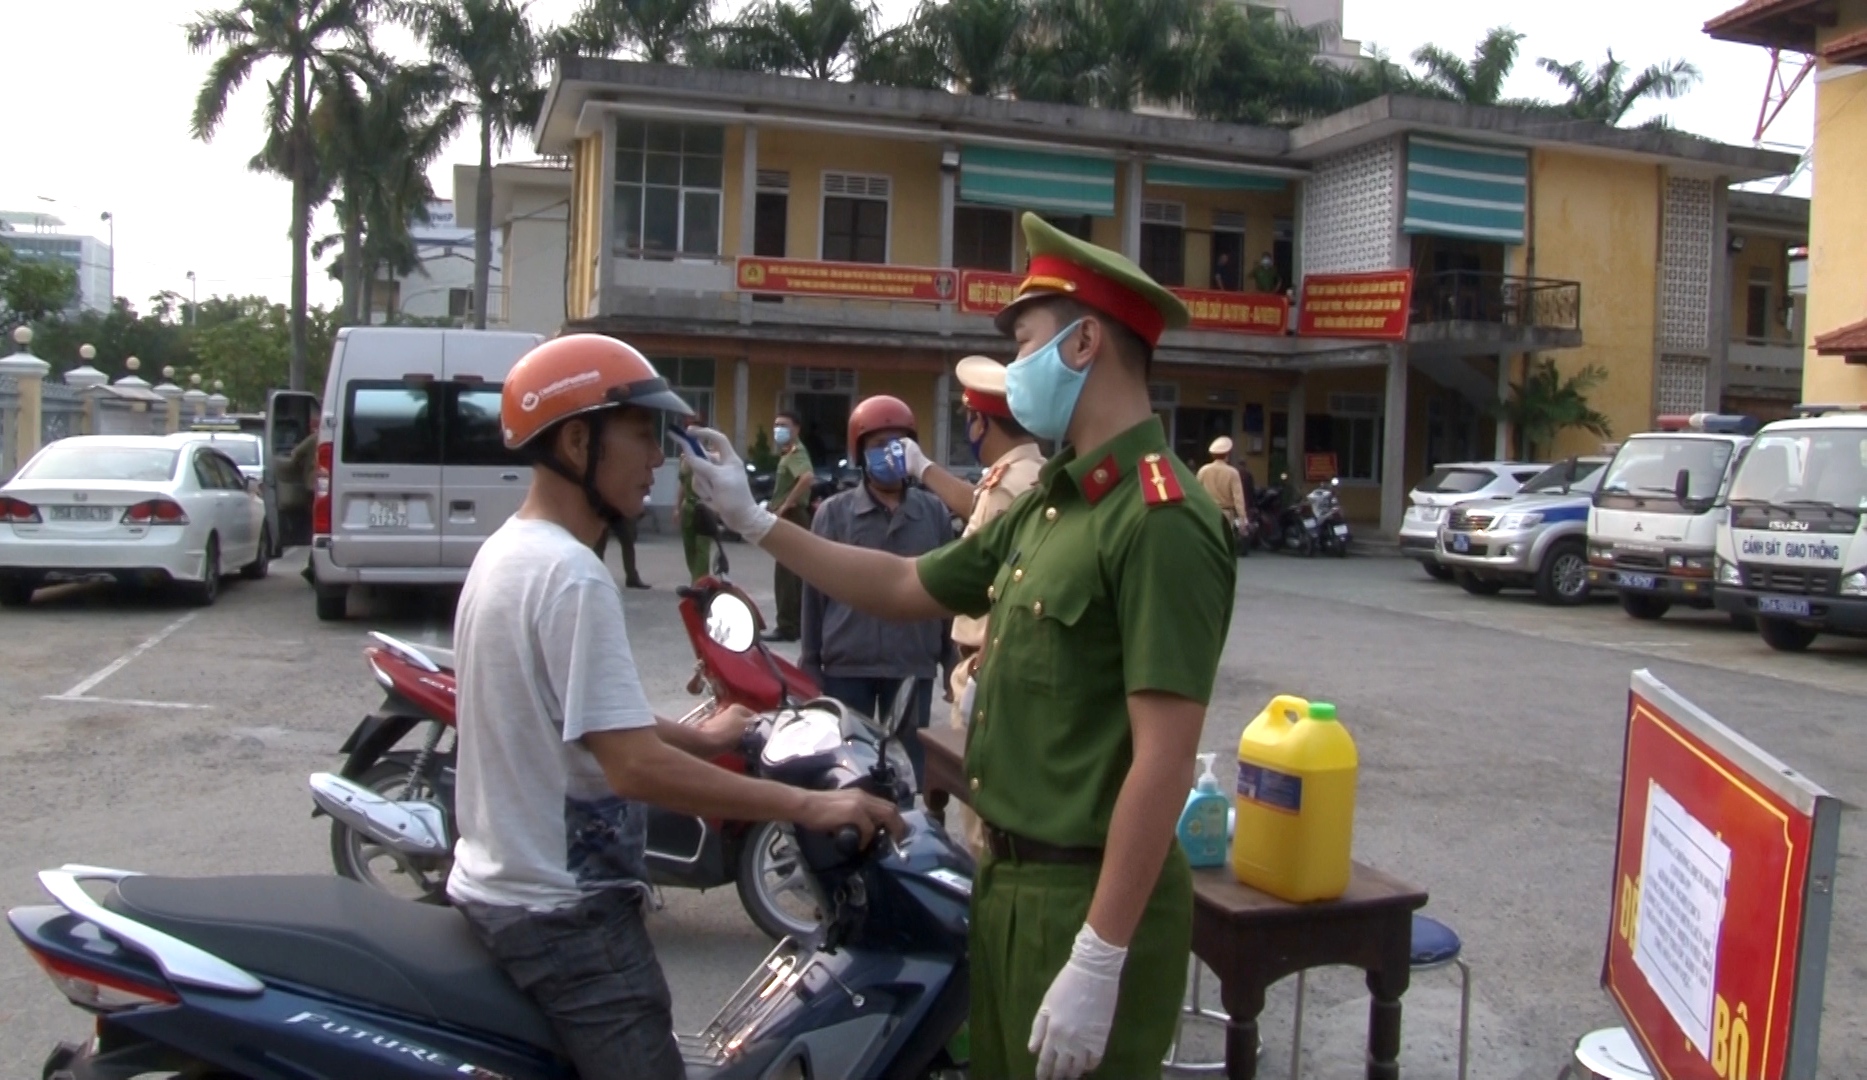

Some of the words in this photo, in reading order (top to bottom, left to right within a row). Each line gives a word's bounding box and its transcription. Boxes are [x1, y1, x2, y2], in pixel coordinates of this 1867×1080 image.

[1769, 520, 1809, 530] ISUZU
[1785, 542, 1807, 558] GIAO
[1808, 540, 1839, 560] THÔNG
